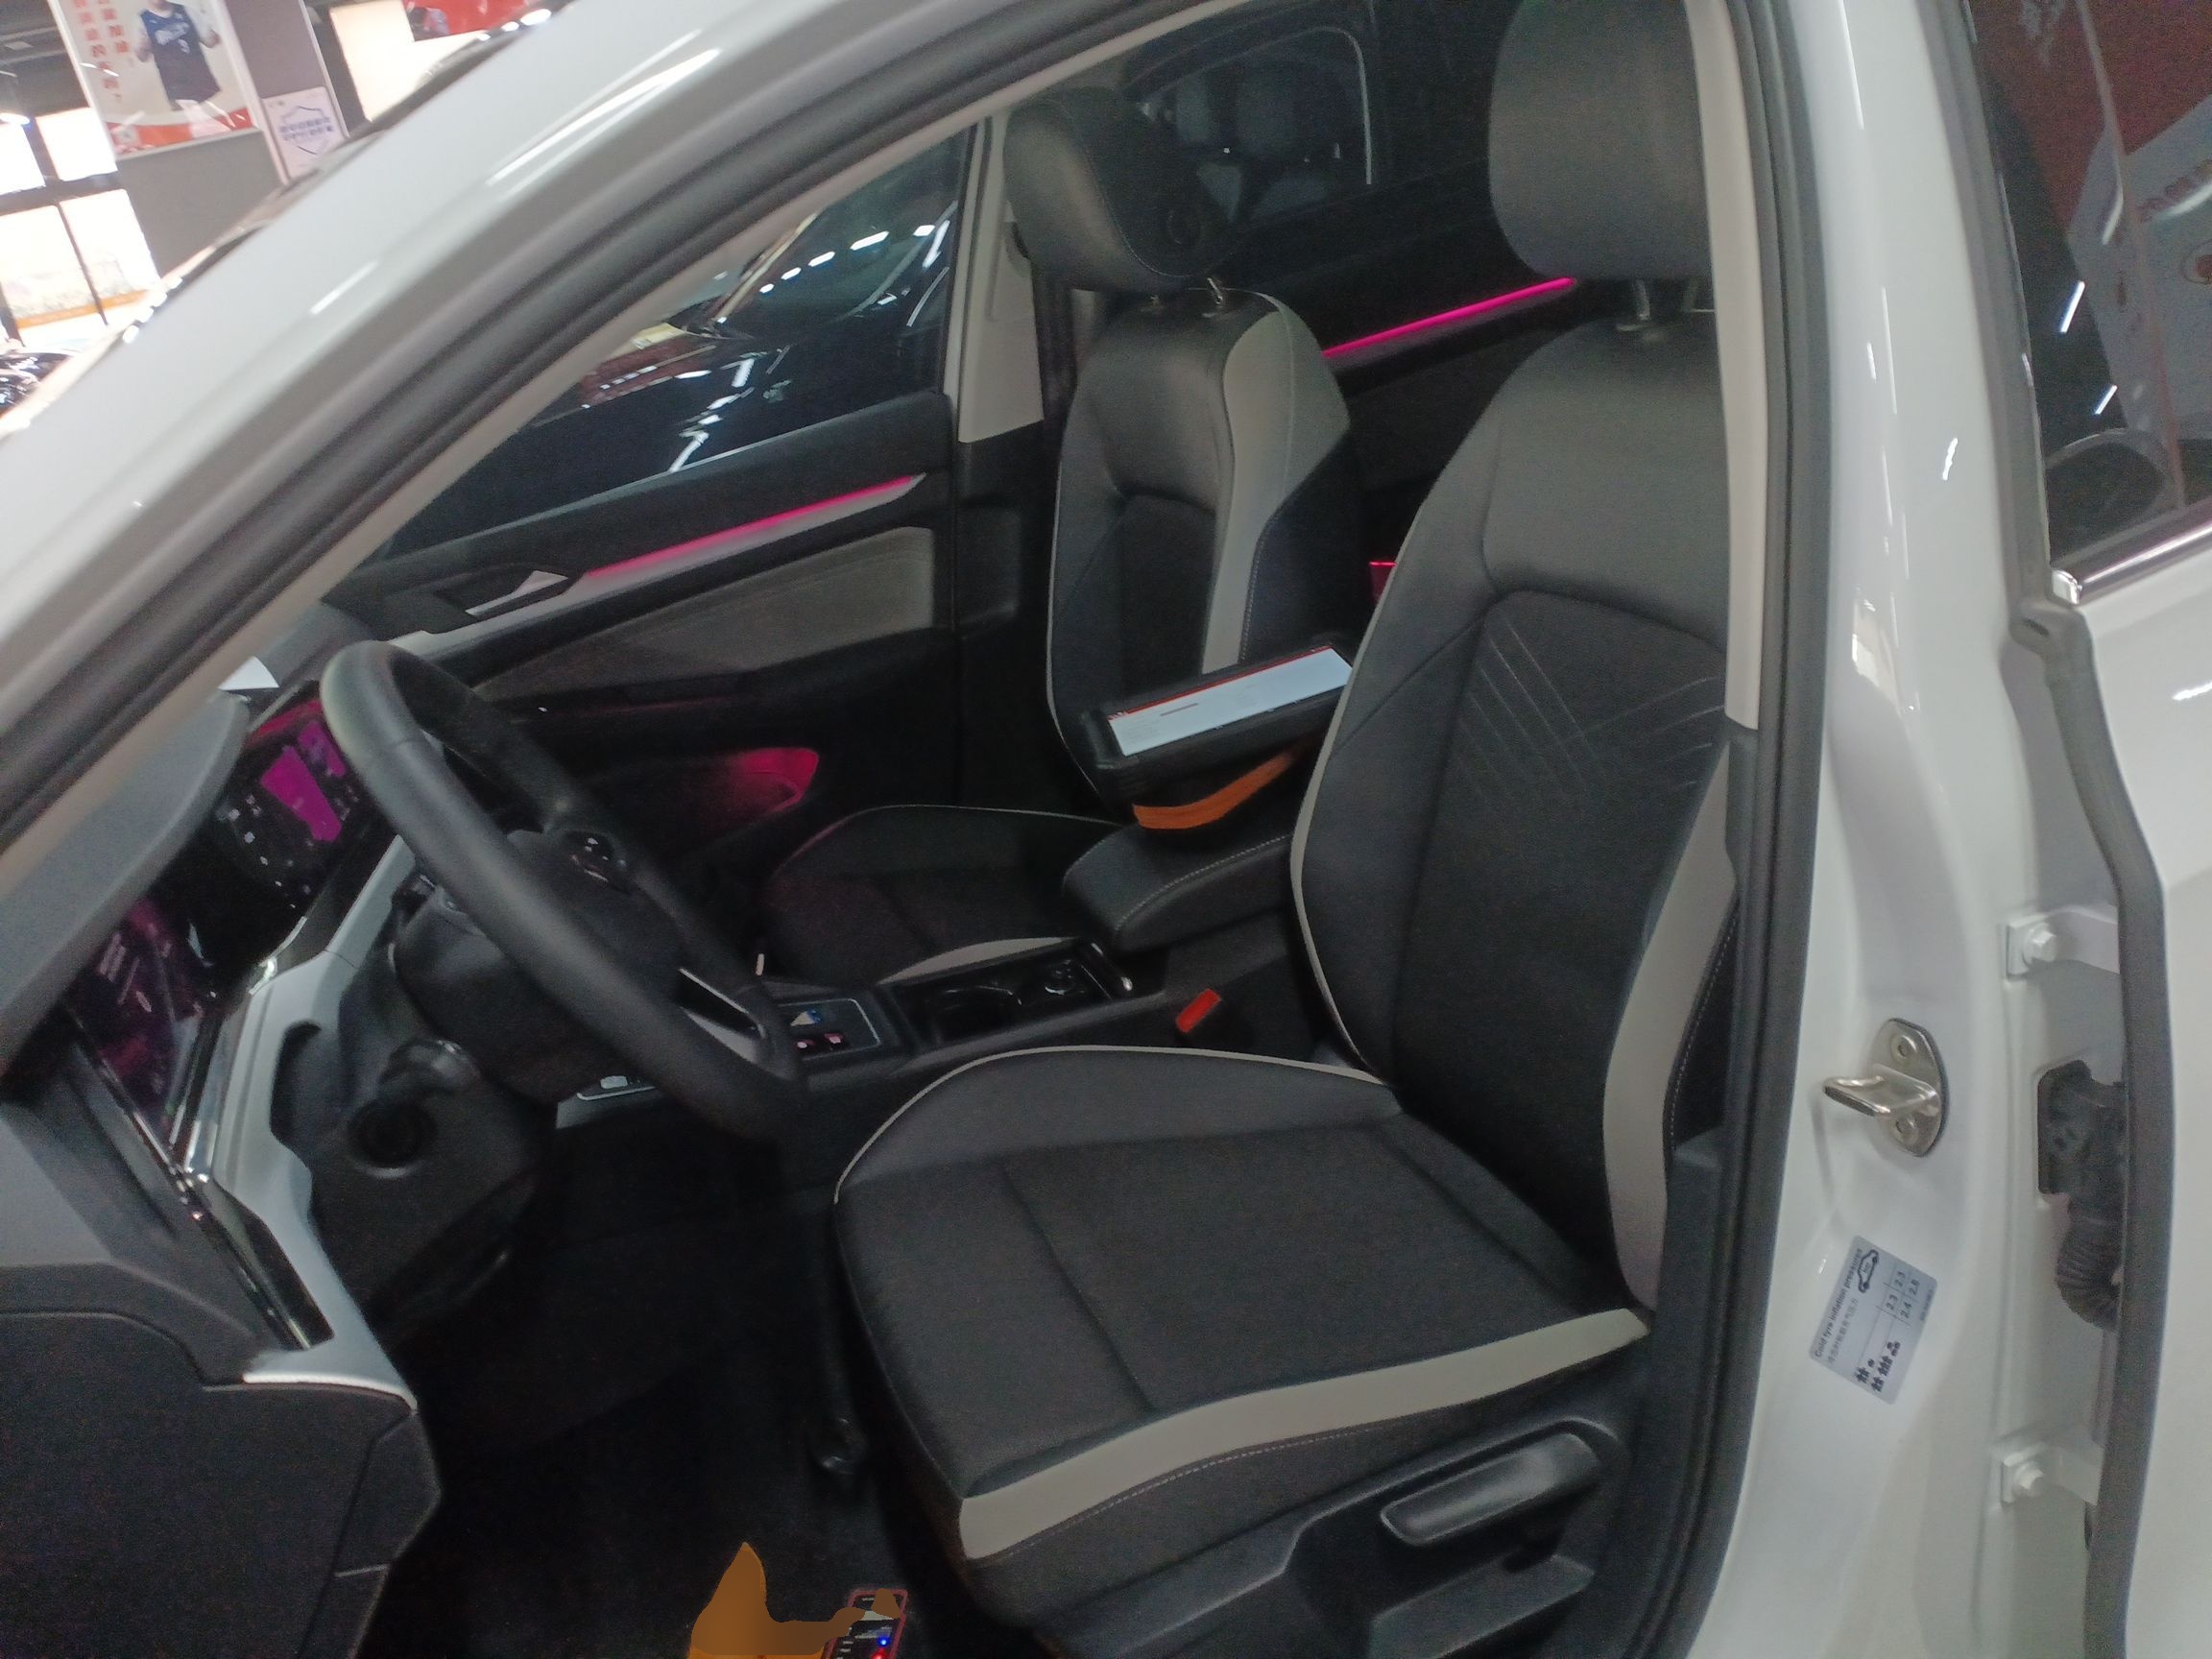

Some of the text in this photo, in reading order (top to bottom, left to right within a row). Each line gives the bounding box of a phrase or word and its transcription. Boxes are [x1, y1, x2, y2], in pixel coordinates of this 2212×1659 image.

[1815, 1336, 1828, 1358] Cold
[1823, 1322, 1834, 1338] tyre
[1831, 1289, 1847, 1321] inflation
